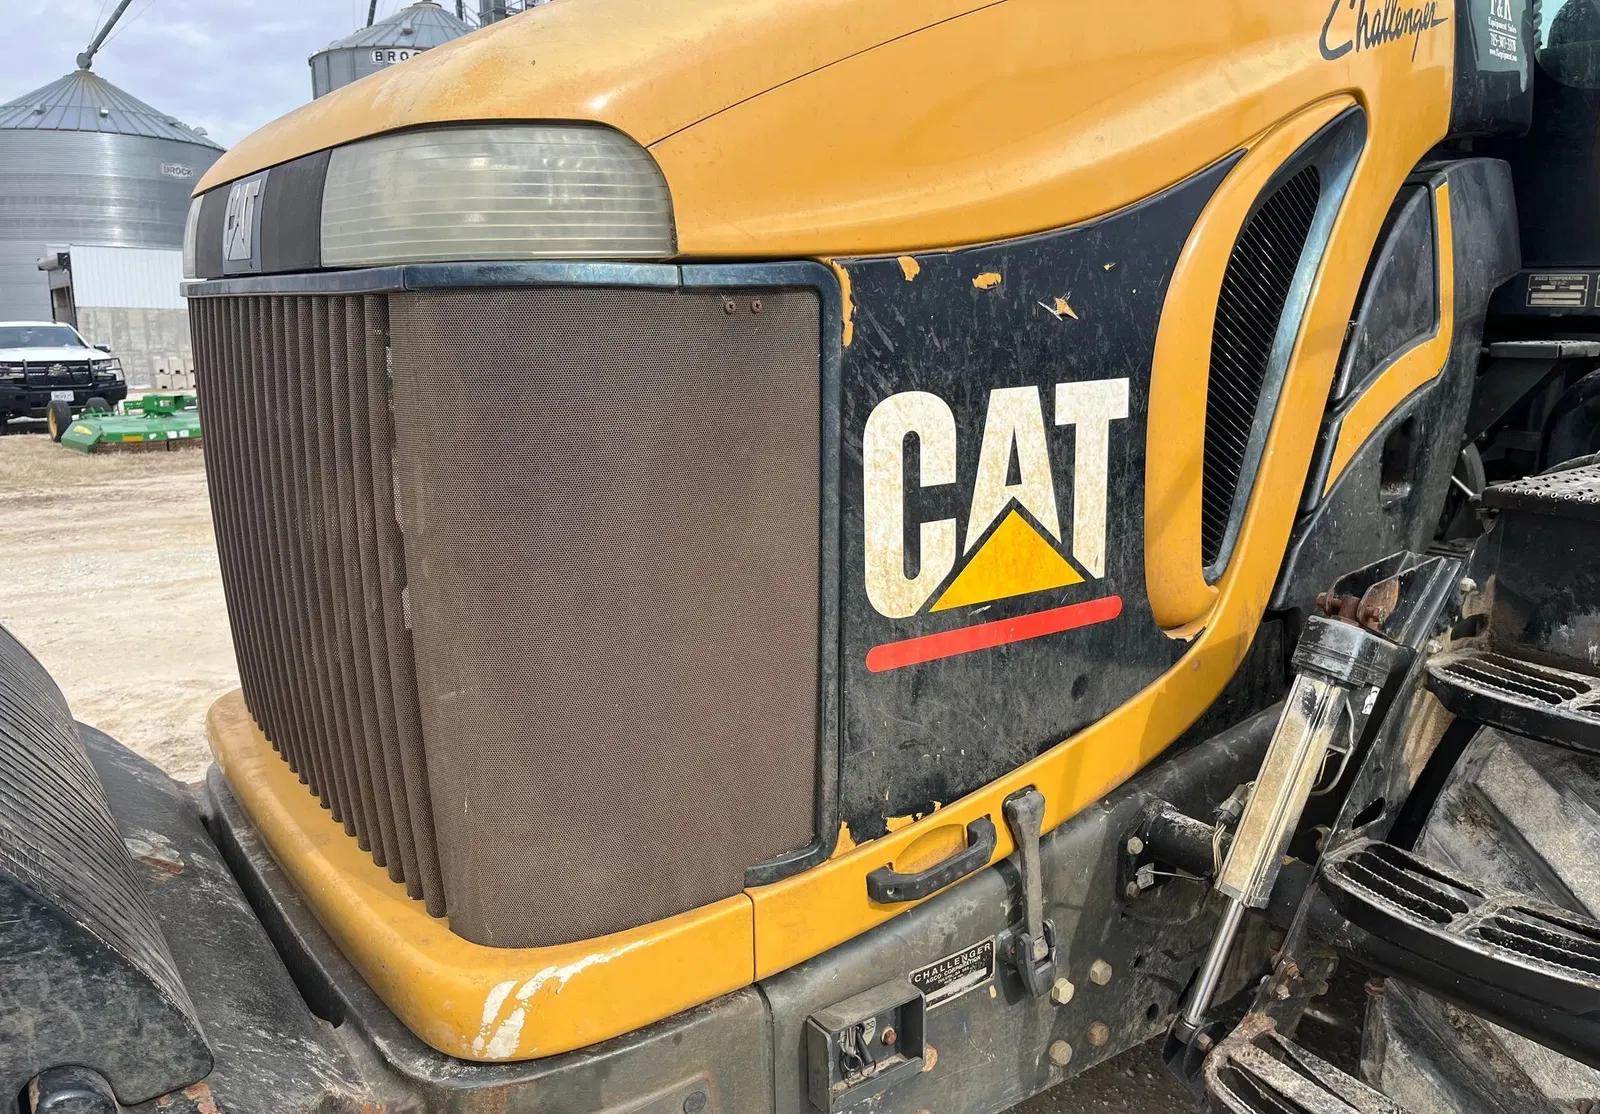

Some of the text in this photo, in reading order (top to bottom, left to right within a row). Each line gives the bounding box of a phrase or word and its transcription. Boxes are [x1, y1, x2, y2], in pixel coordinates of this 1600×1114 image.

[1319, 0, 1448, 62] Challenger
[1488, 16, 1517, 33] Equipment Sales
[375, 51, 420, 61] BRO
[163, 165, 191, 176] BROCK
[223, 180, 261, 261] CAT
[863, 377, 1130, 619] CAT
[914, 942, 991, 983] CHALLENGER
[925, 956, 981, 985] AGCO CORPORATION
